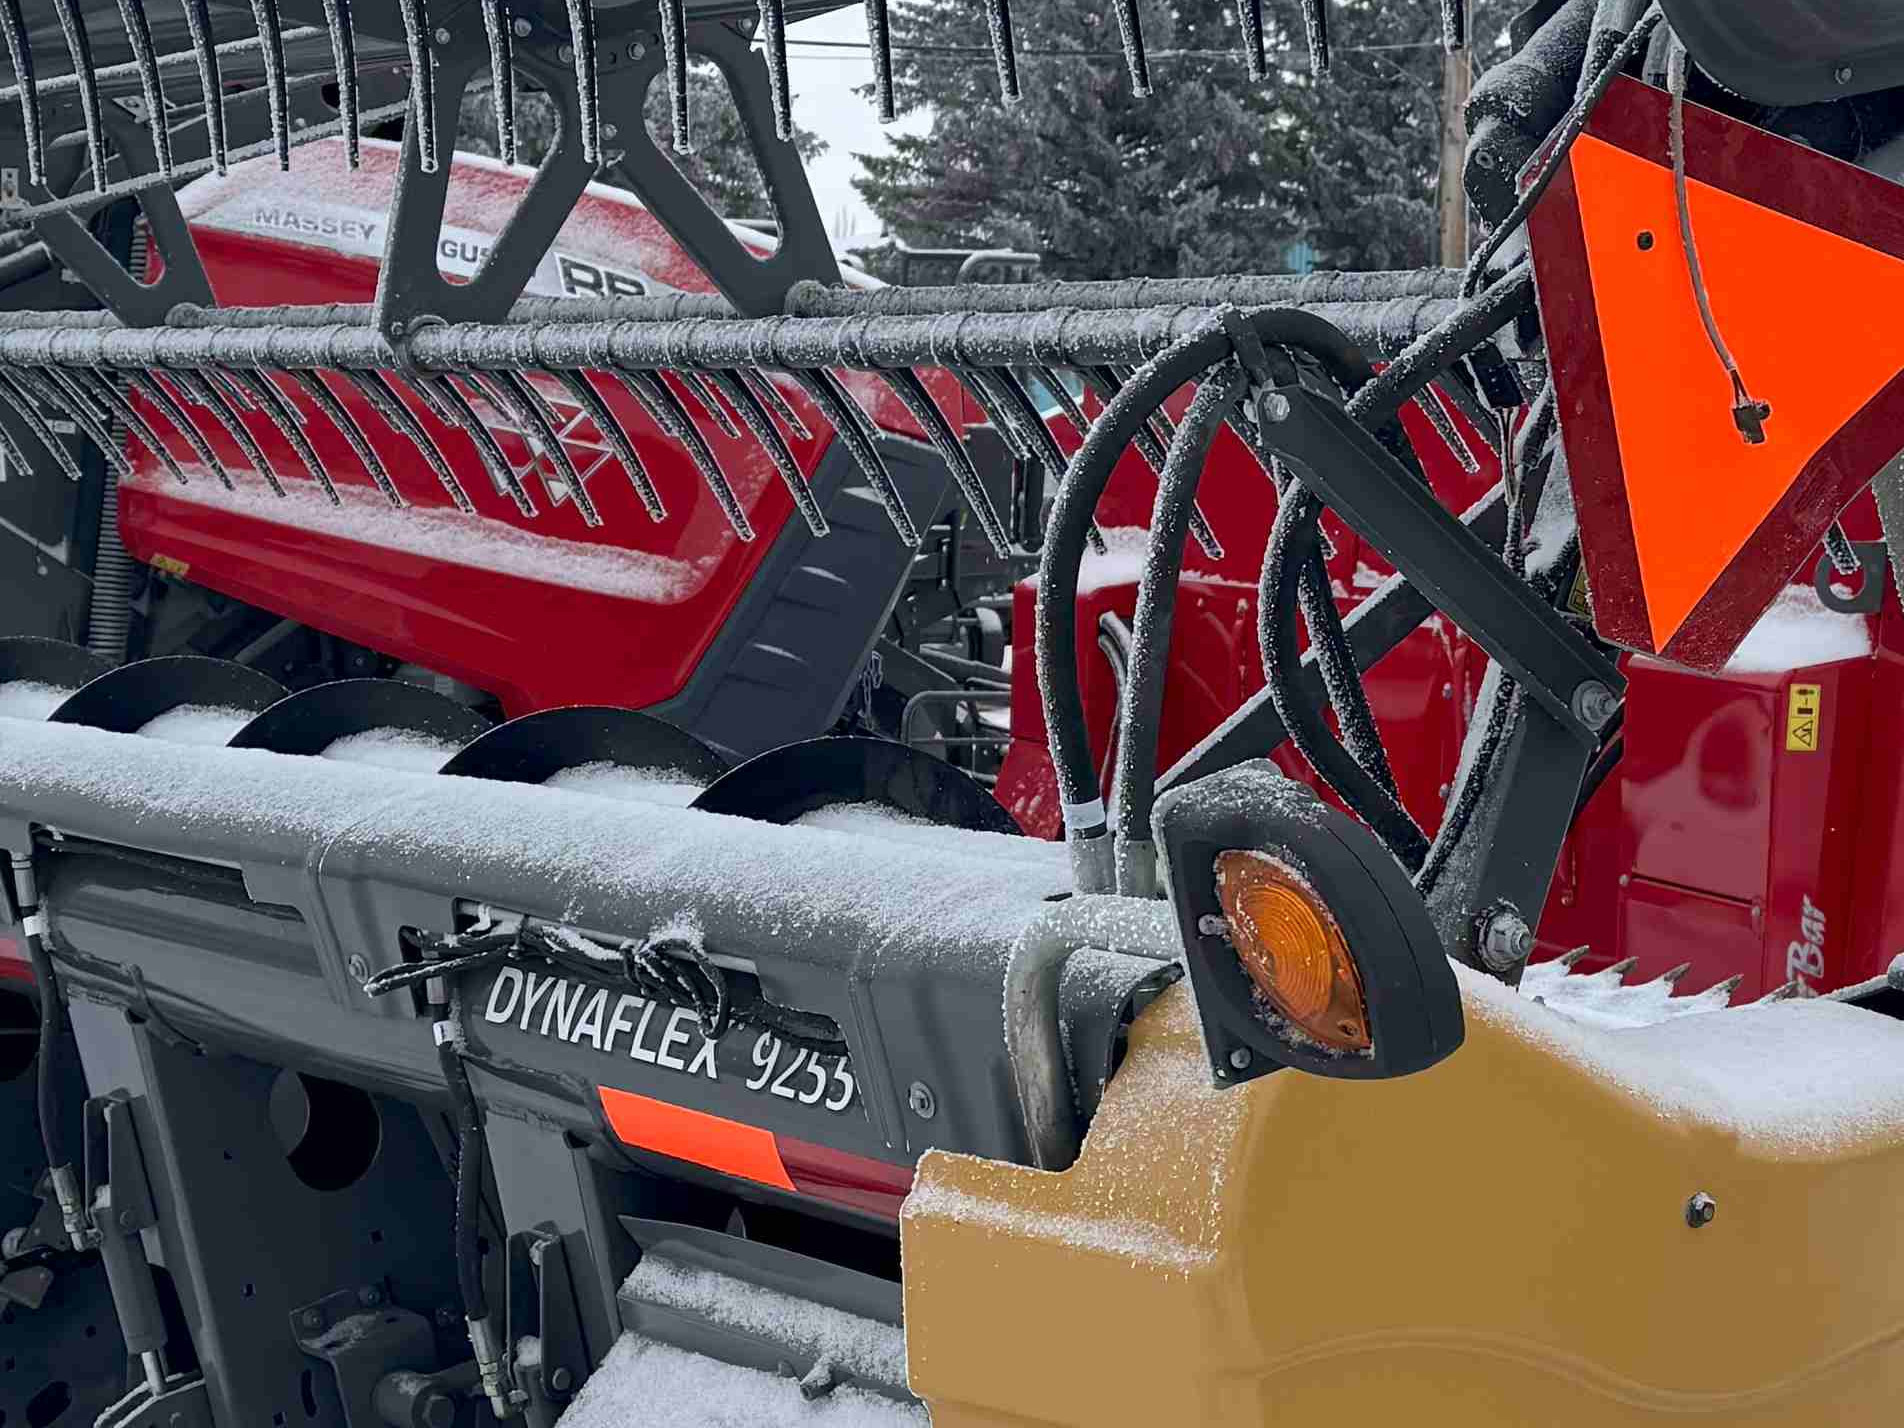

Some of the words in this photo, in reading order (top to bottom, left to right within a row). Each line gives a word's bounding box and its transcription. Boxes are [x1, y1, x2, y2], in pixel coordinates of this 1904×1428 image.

[255, 209, 376, 240] MASSEY
[485, 966, 719, 1080] DYNAFLEX
[745, 1030, 855, 1112] 9255
